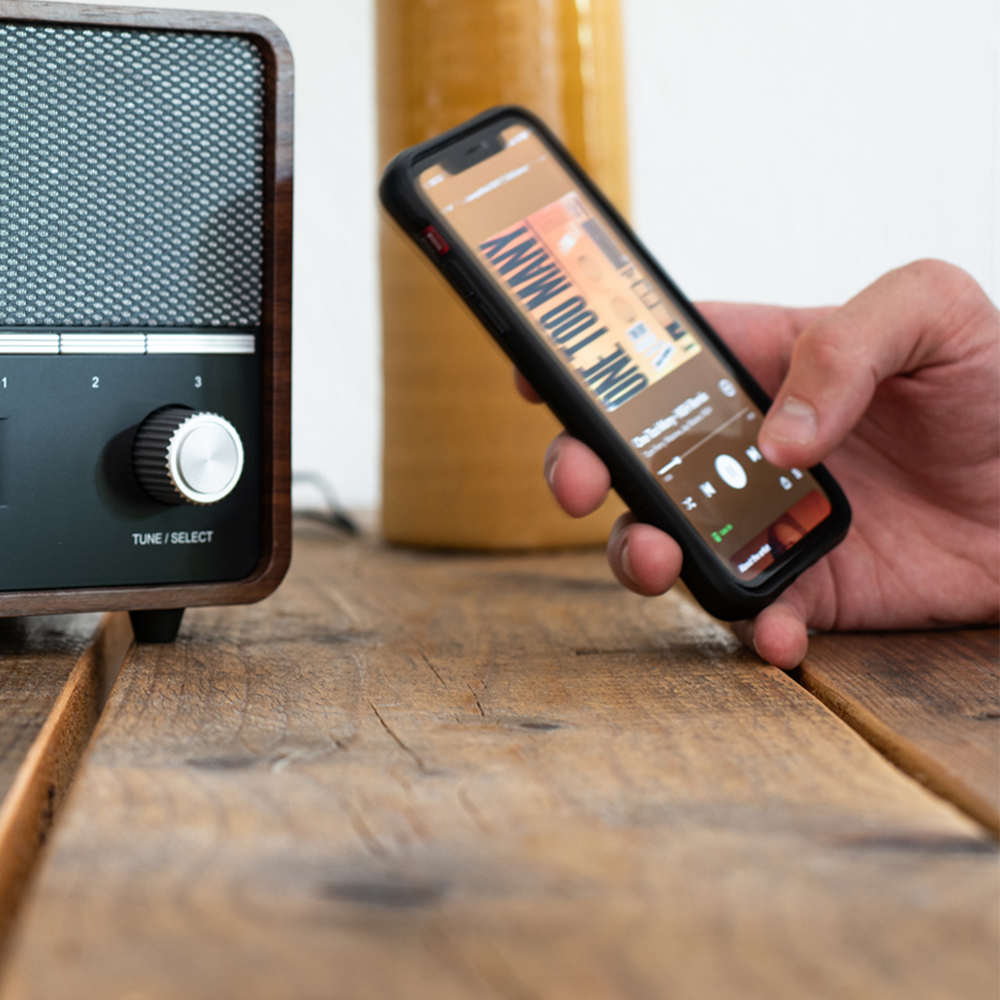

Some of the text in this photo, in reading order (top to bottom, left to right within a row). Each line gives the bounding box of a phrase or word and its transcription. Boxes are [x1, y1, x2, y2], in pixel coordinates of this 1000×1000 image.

[478, 223, 572, 311] MANY
[537, 294, 610, 362] TOO
[1, 376, 7, 389] 1
[91, 375, 100, 389] 2
[194, 375, 203, 389] 3
[576, 342, 650, 411] ONE
[131, 532, 162, 546] TUNE
[170, 530, 214, 545] SELECT
